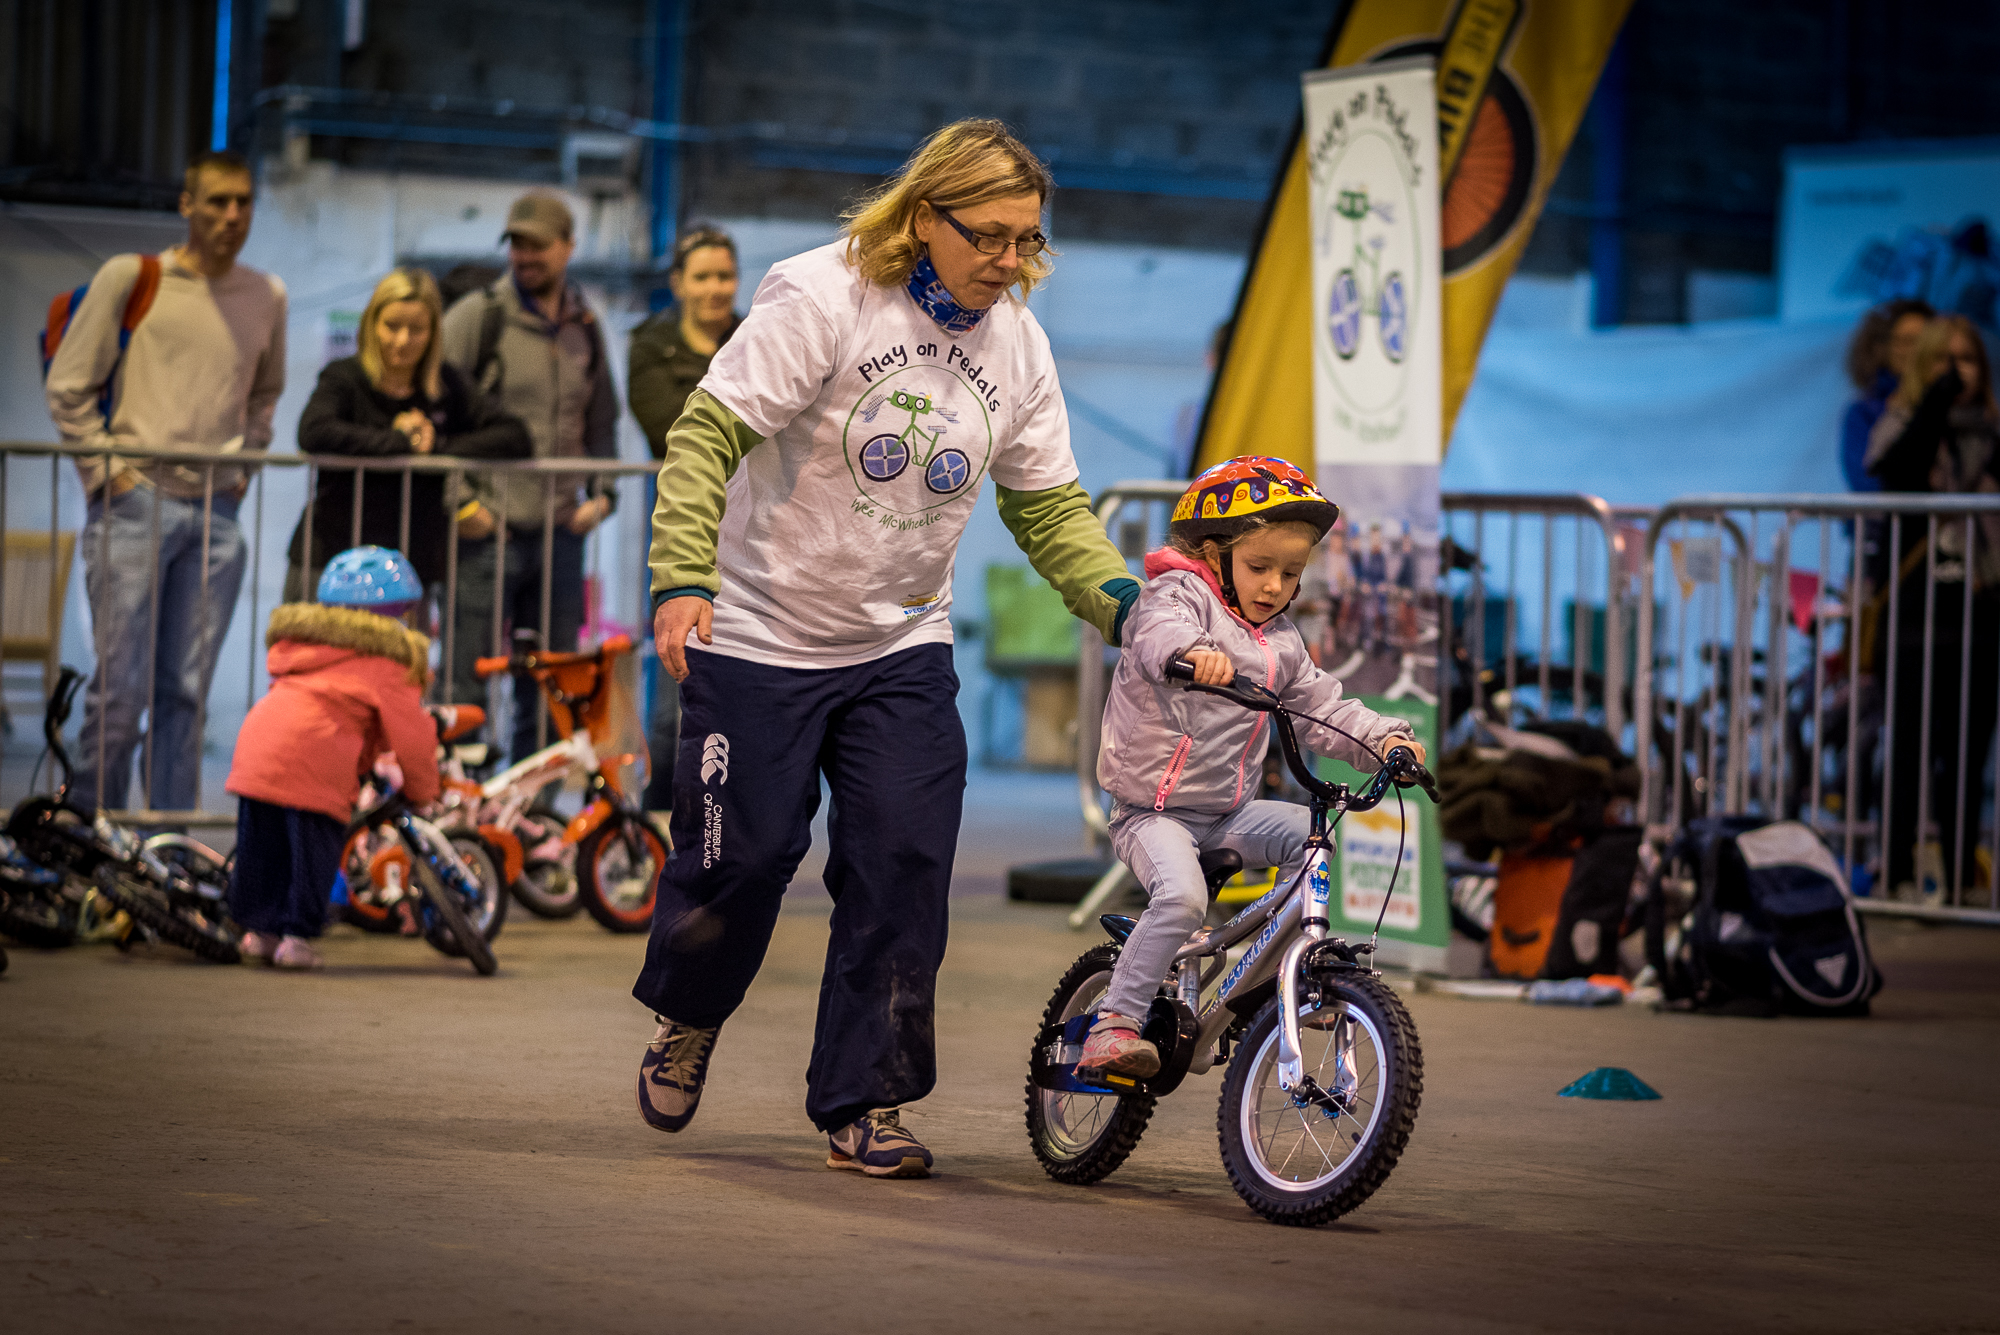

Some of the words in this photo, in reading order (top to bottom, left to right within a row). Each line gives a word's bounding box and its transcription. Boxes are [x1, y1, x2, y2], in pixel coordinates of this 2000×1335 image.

[858, 344, 908, 383] Play
[916, 342, 937, 357] on
[947, 344, 1000, 412] Pedals
[851, 498, 875, 518] Wee
[879, 512, 942, 531] McWheelie
[704, 793, 712, 806] OF
[704, 807, 712, 828] NEW
[703, 829, 712, 869] ZEALAND
[712, 804, 722, 861] CANTERBURY
